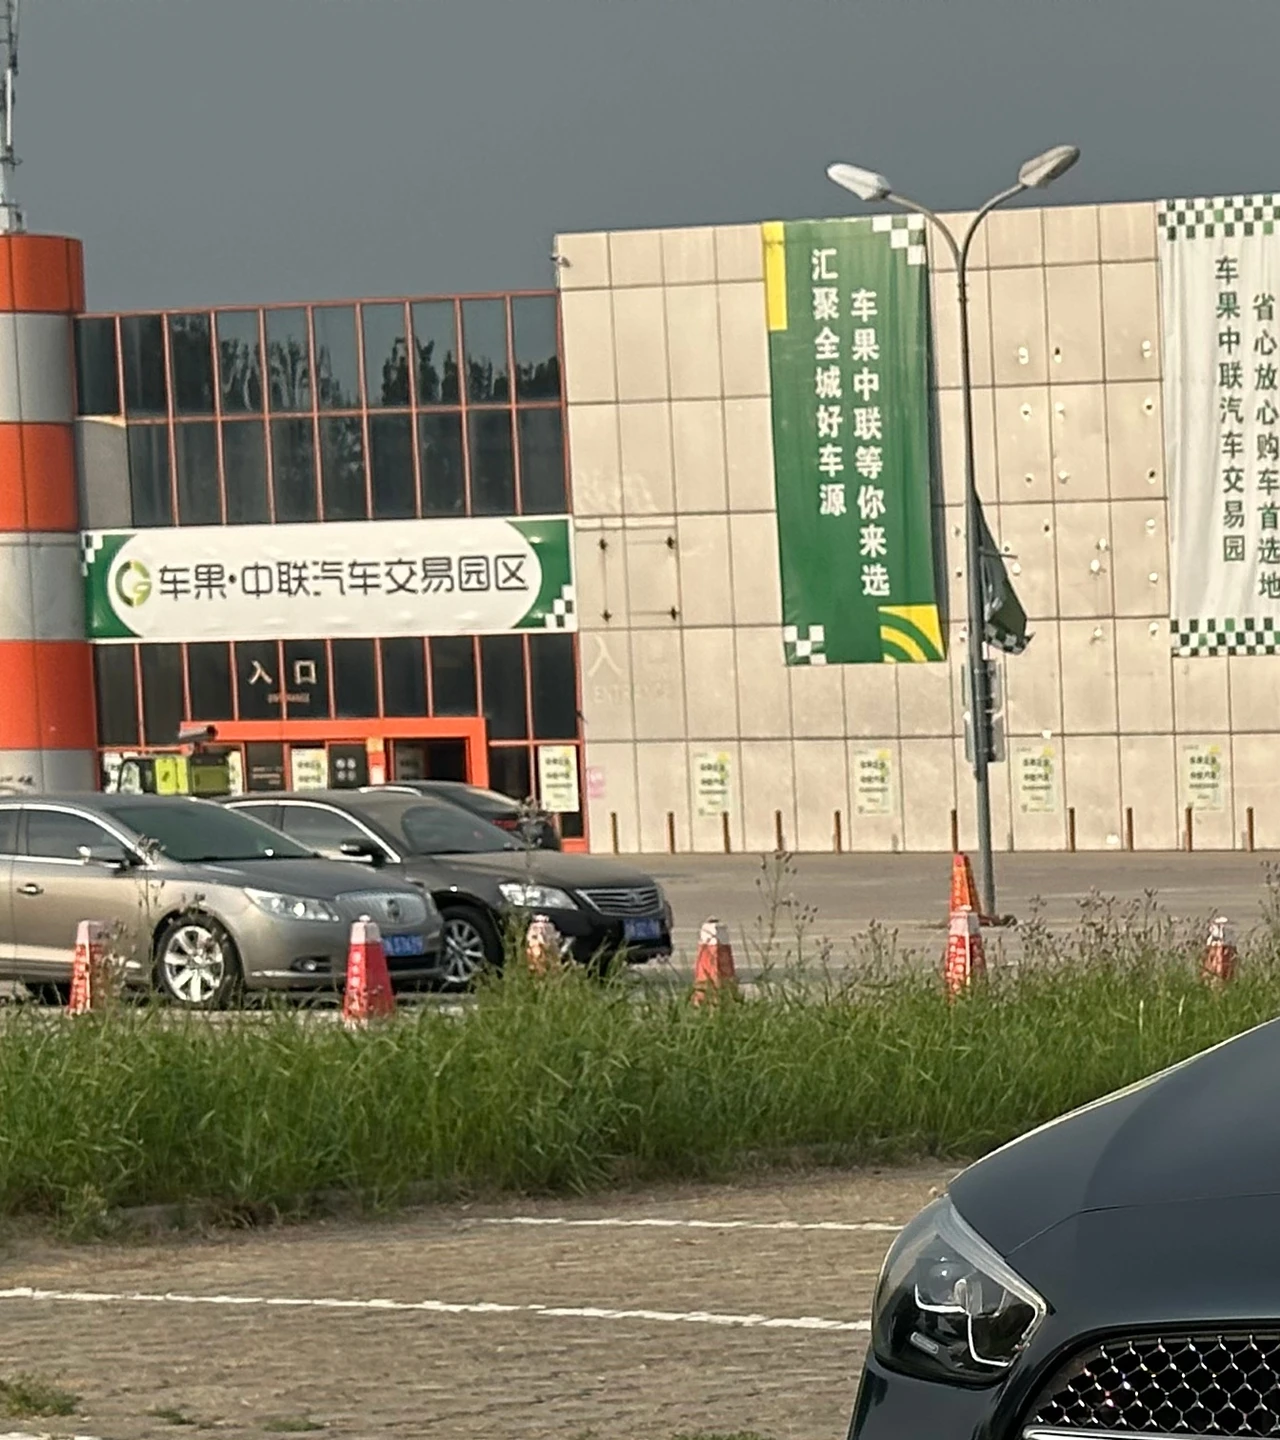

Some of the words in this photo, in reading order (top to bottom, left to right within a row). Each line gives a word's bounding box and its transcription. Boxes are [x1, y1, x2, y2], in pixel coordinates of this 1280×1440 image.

[811, 247, 846, 517] 汇聚全城好车源
[850, 287, 890, 597] 车果中联等你来选
[1214, 255, 1246, 563] 车果中联汽车交易园
[158, 554, 528, 600] 车果·中联汽车交易园区
[249, 659, 318, 685] 入口
